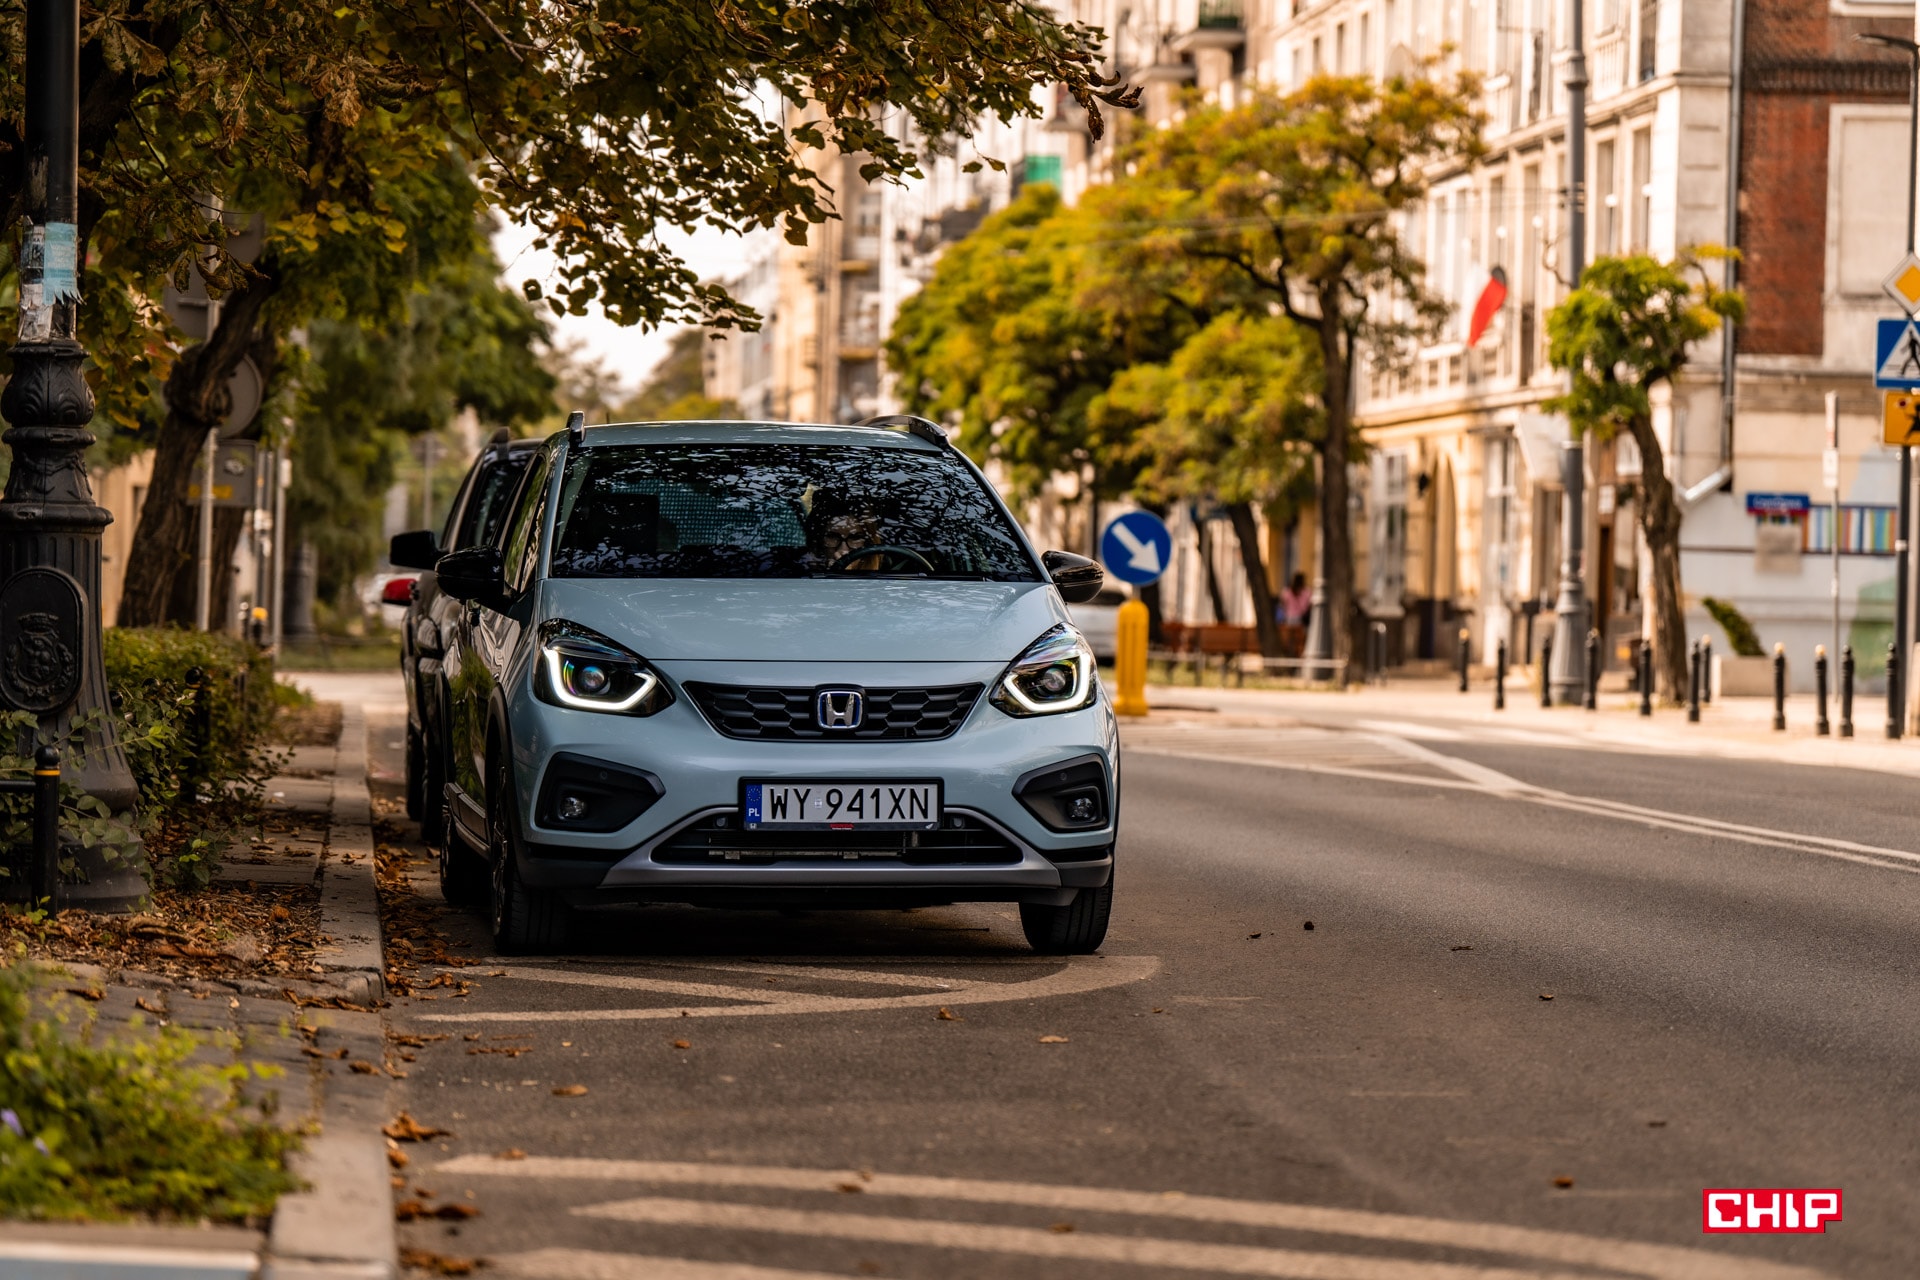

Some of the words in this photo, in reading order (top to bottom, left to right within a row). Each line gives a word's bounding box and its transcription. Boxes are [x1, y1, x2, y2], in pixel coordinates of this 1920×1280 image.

[748, 808, 760, 817] PL
[769, 788, 811, 820] WY
[825, 788, 929, 820] 941XN
